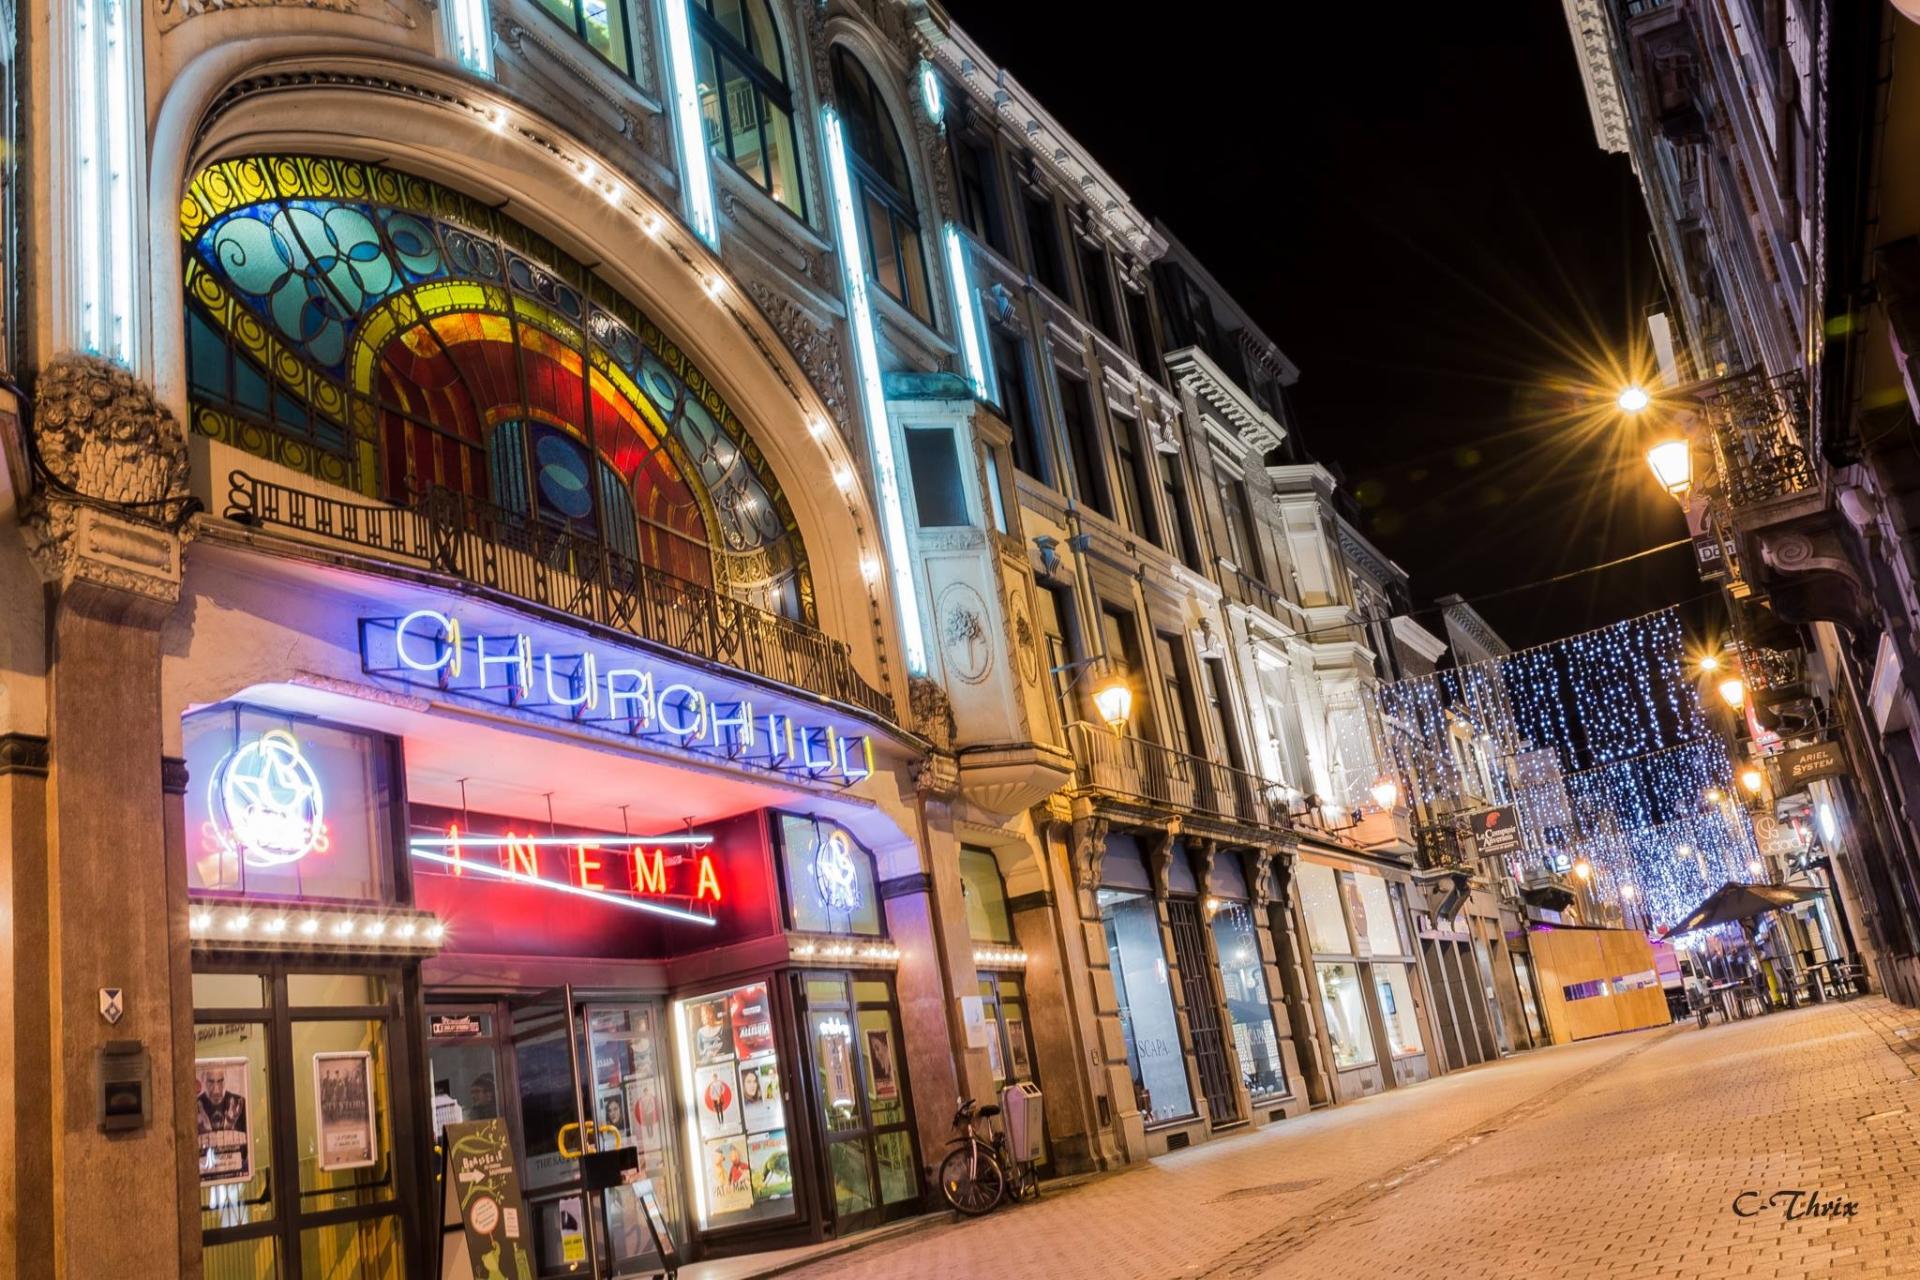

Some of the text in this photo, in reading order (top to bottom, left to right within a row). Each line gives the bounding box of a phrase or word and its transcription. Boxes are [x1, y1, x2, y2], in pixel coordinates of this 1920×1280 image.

[397, 608, 876, 781] CHURCHILL
[1799, 751, 1829, 764] ARIEL
[1137, 1038, 1170, 1058] SCAPA
